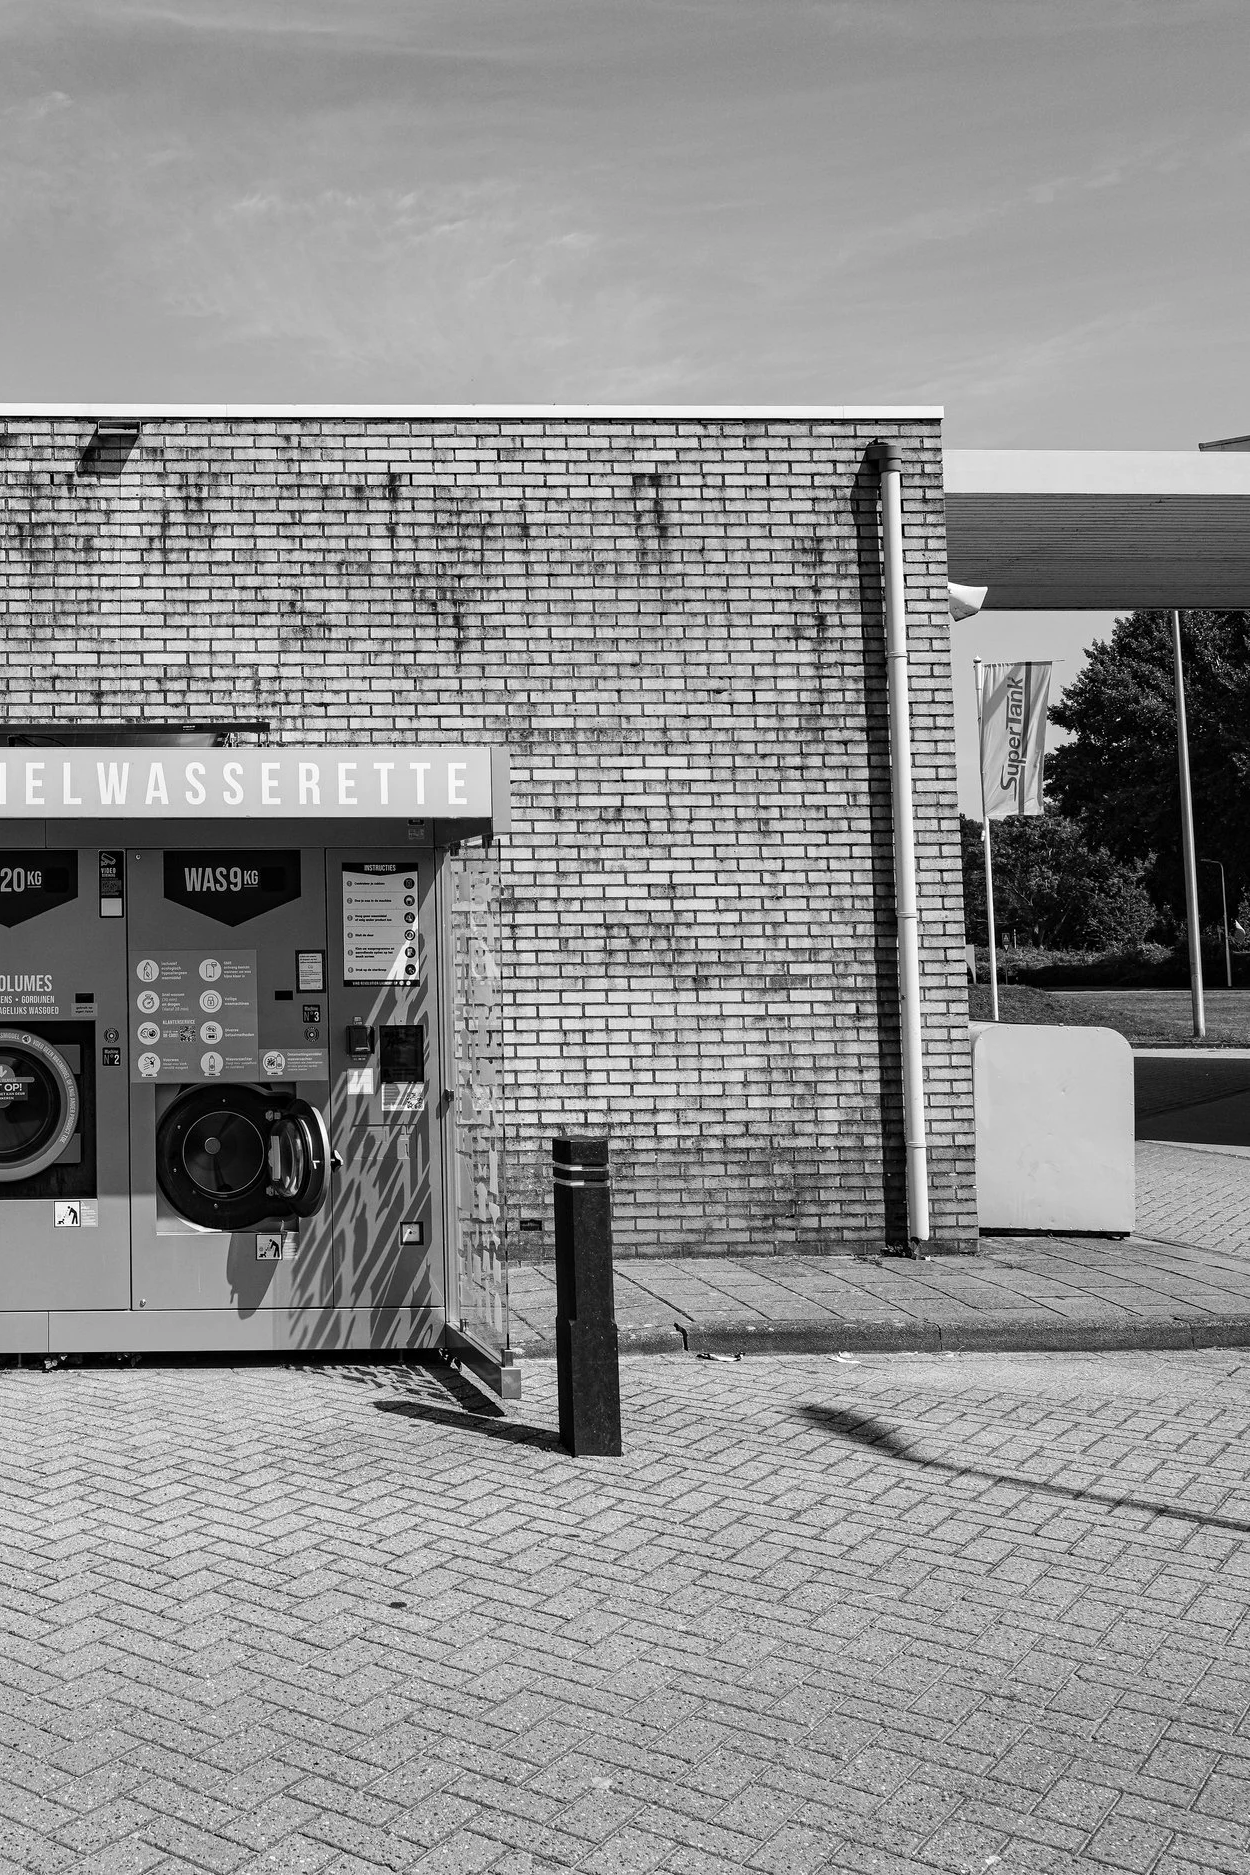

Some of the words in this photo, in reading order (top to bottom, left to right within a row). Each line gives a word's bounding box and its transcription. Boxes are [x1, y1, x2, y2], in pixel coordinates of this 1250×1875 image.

[1000, 676, 1026, 801] SuperTank
[0, 868, 25, 893] 20
[27, 871, 43, 886] KG
[184, 867, 227, 892] WAS
[229, 867, 243, 892] 9
[244, 871, 259, 886] KG
[21, 996, 55, 1004] GORDIJNEN
[28, 1006, 59, 1015] WASGOED
[52, 1054, 70, 1079] WASMIDDEL
[4, 1083, 22, 1092] OP!
